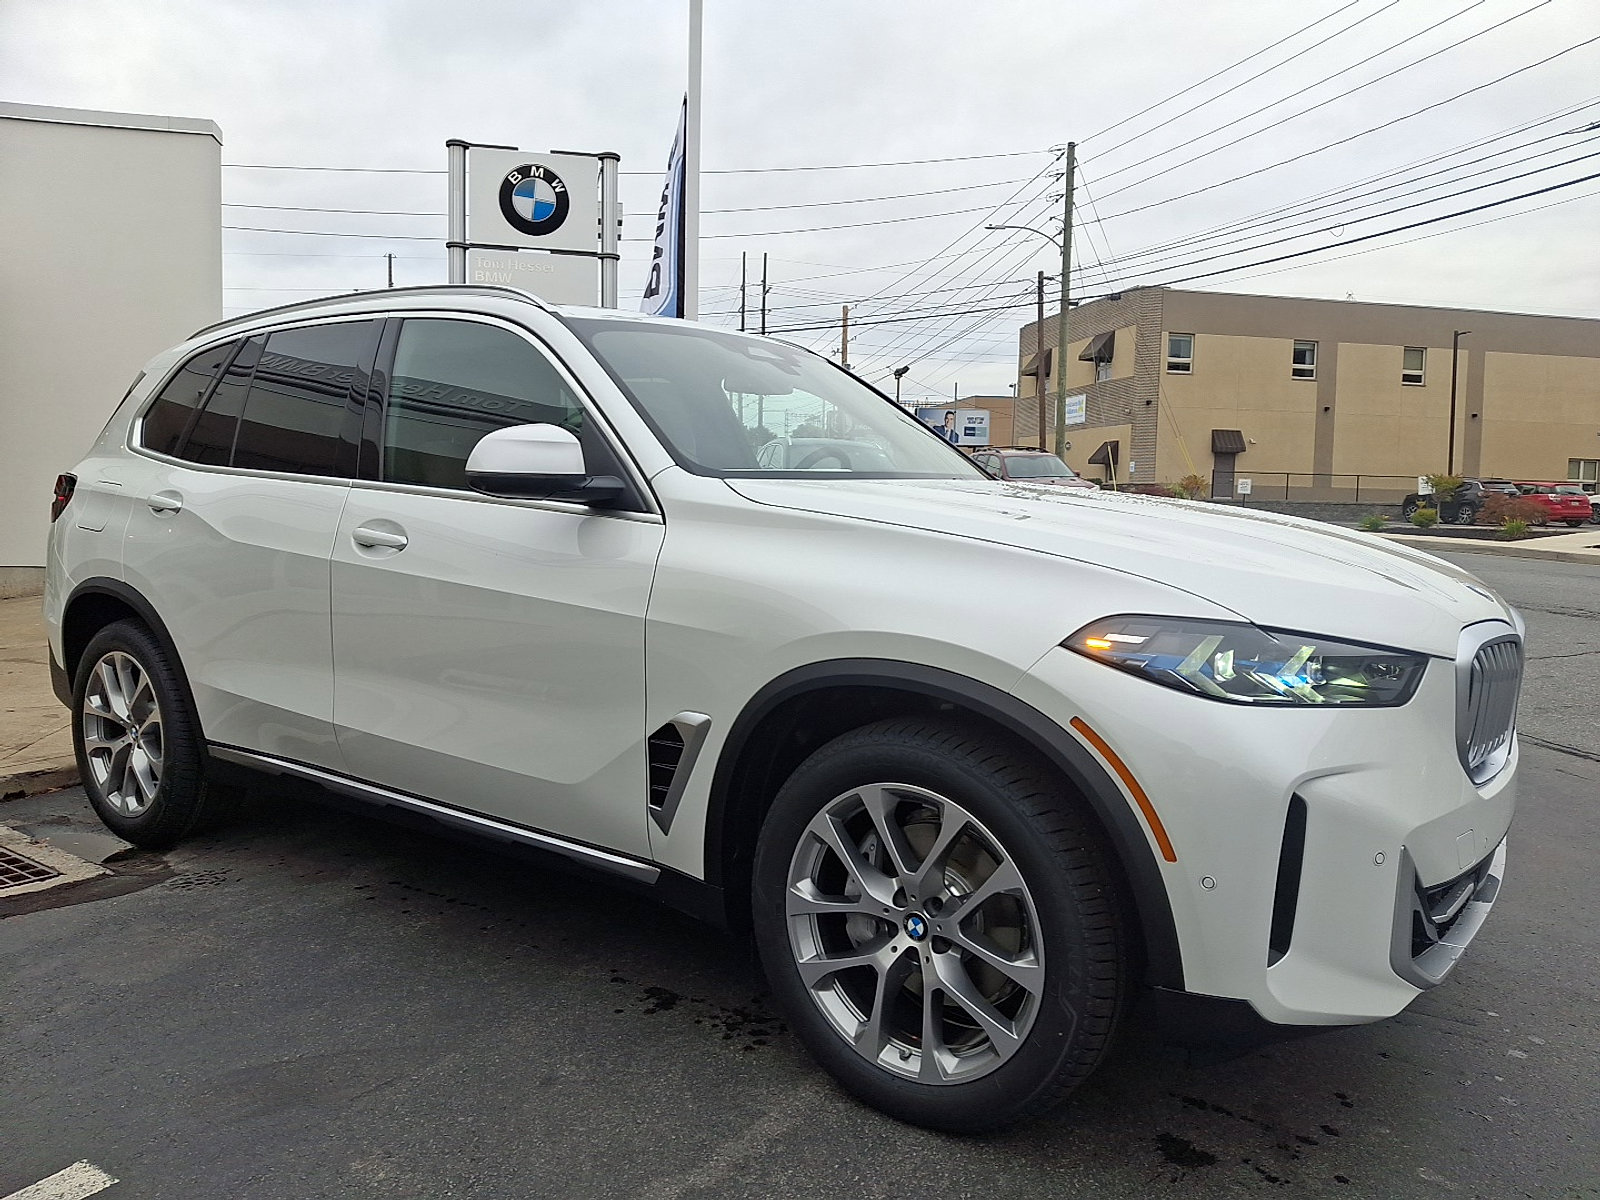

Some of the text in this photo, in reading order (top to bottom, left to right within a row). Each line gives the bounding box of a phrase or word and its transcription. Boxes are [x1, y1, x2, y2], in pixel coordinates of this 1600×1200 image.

[507, 166, 565, 192] BMW
[475, 256, 554, 273] Tom Hesser
[475, 270, 512, 283] BMW
